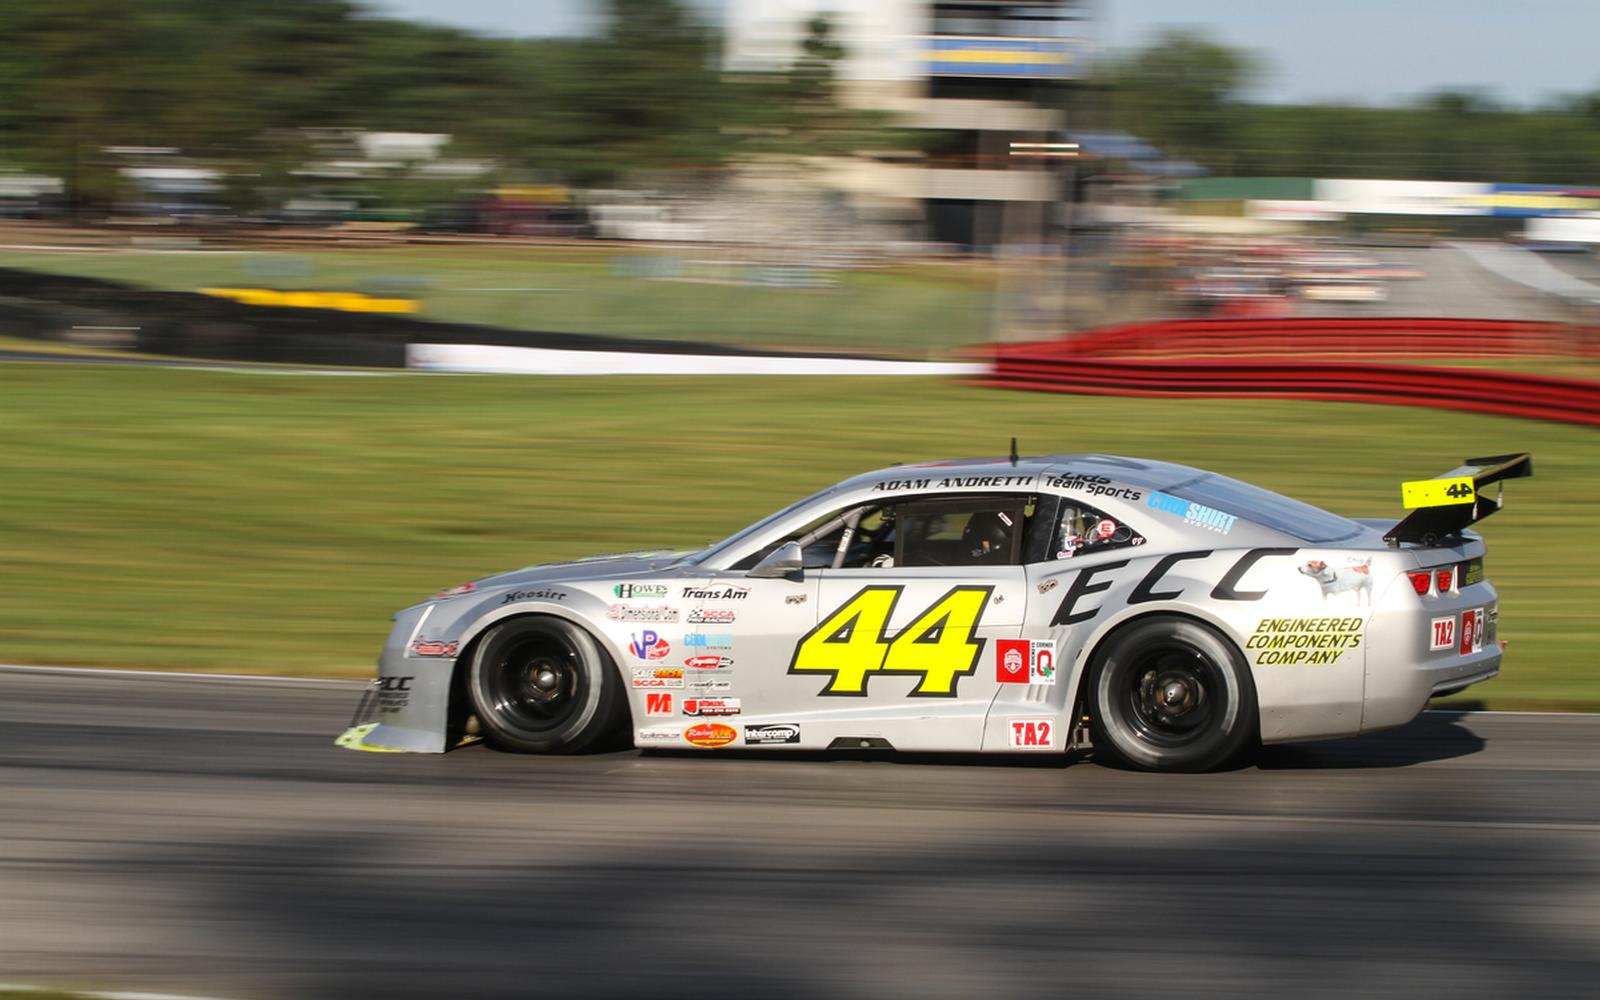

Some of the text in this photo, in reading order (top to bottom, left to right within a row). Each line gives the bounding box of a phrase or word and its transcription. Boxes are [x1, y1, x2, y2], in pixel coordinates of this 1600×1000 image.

[871, 476, 1033, 492] ADAM ANDRETTI
[1046, 476, 1142, 501] Team Sports
[1446, 483, 1473, 498] 44
[682, 587, 748, 599] Trans Am
[1049, 547, 1300, 628] ECC
[501, 588, 567, 604] Hoosier
[703, 610, 735, 618] SCCA
[1255, 618, 1363, 633] ENGINEERED
[787, 585, 995, 698] 44
[1246, 634, 1363, 649] COMPONENTS
[1433, 621, 1454, 647] TA2
[631, 630, 658, 659] VP
[1255, 651, 1344, 665] COMPANY
[745, 728, 793, 740] Intercomp
[1012, 722, 1050, 746] TA2
